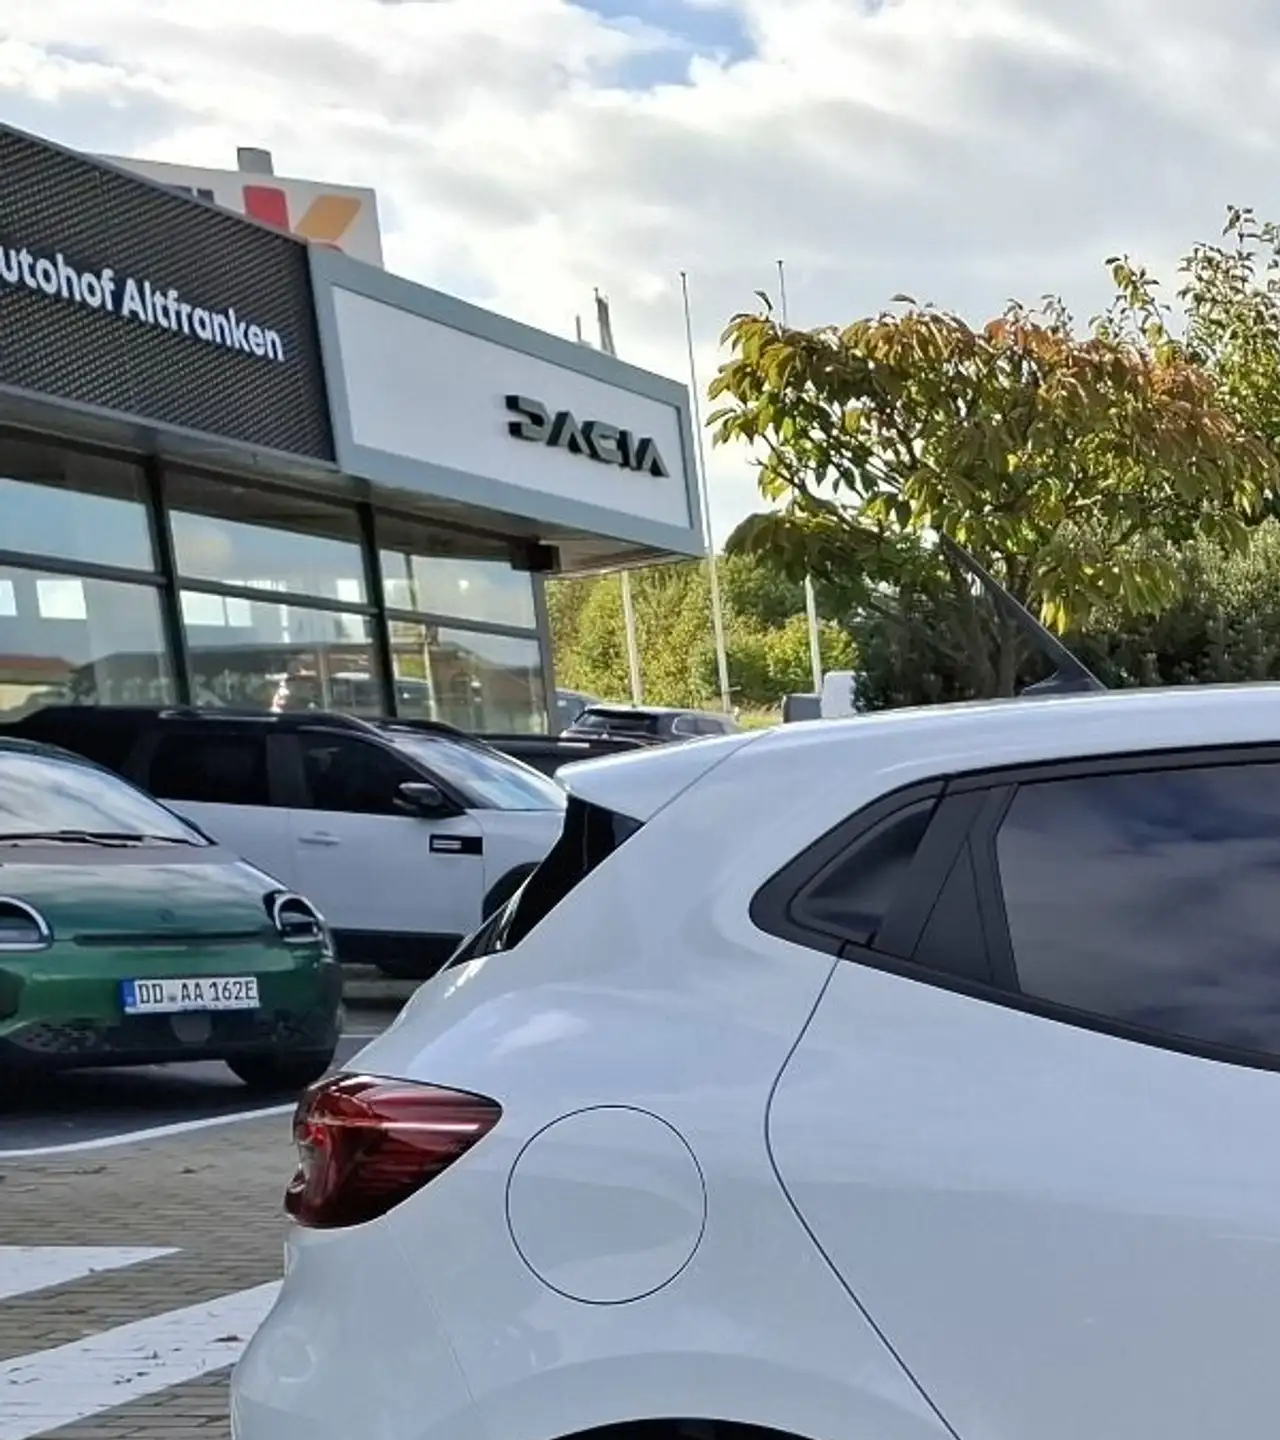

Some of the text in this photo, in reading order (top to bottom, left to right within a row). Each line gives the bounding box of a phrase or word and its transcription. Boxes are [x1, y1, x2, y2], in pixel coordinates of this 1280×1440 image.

[121, 277, 285, 362] Altfranken
[505, 394, 670, 478] DACIA
[138, 980, 258, 1004] DD AA 162E
